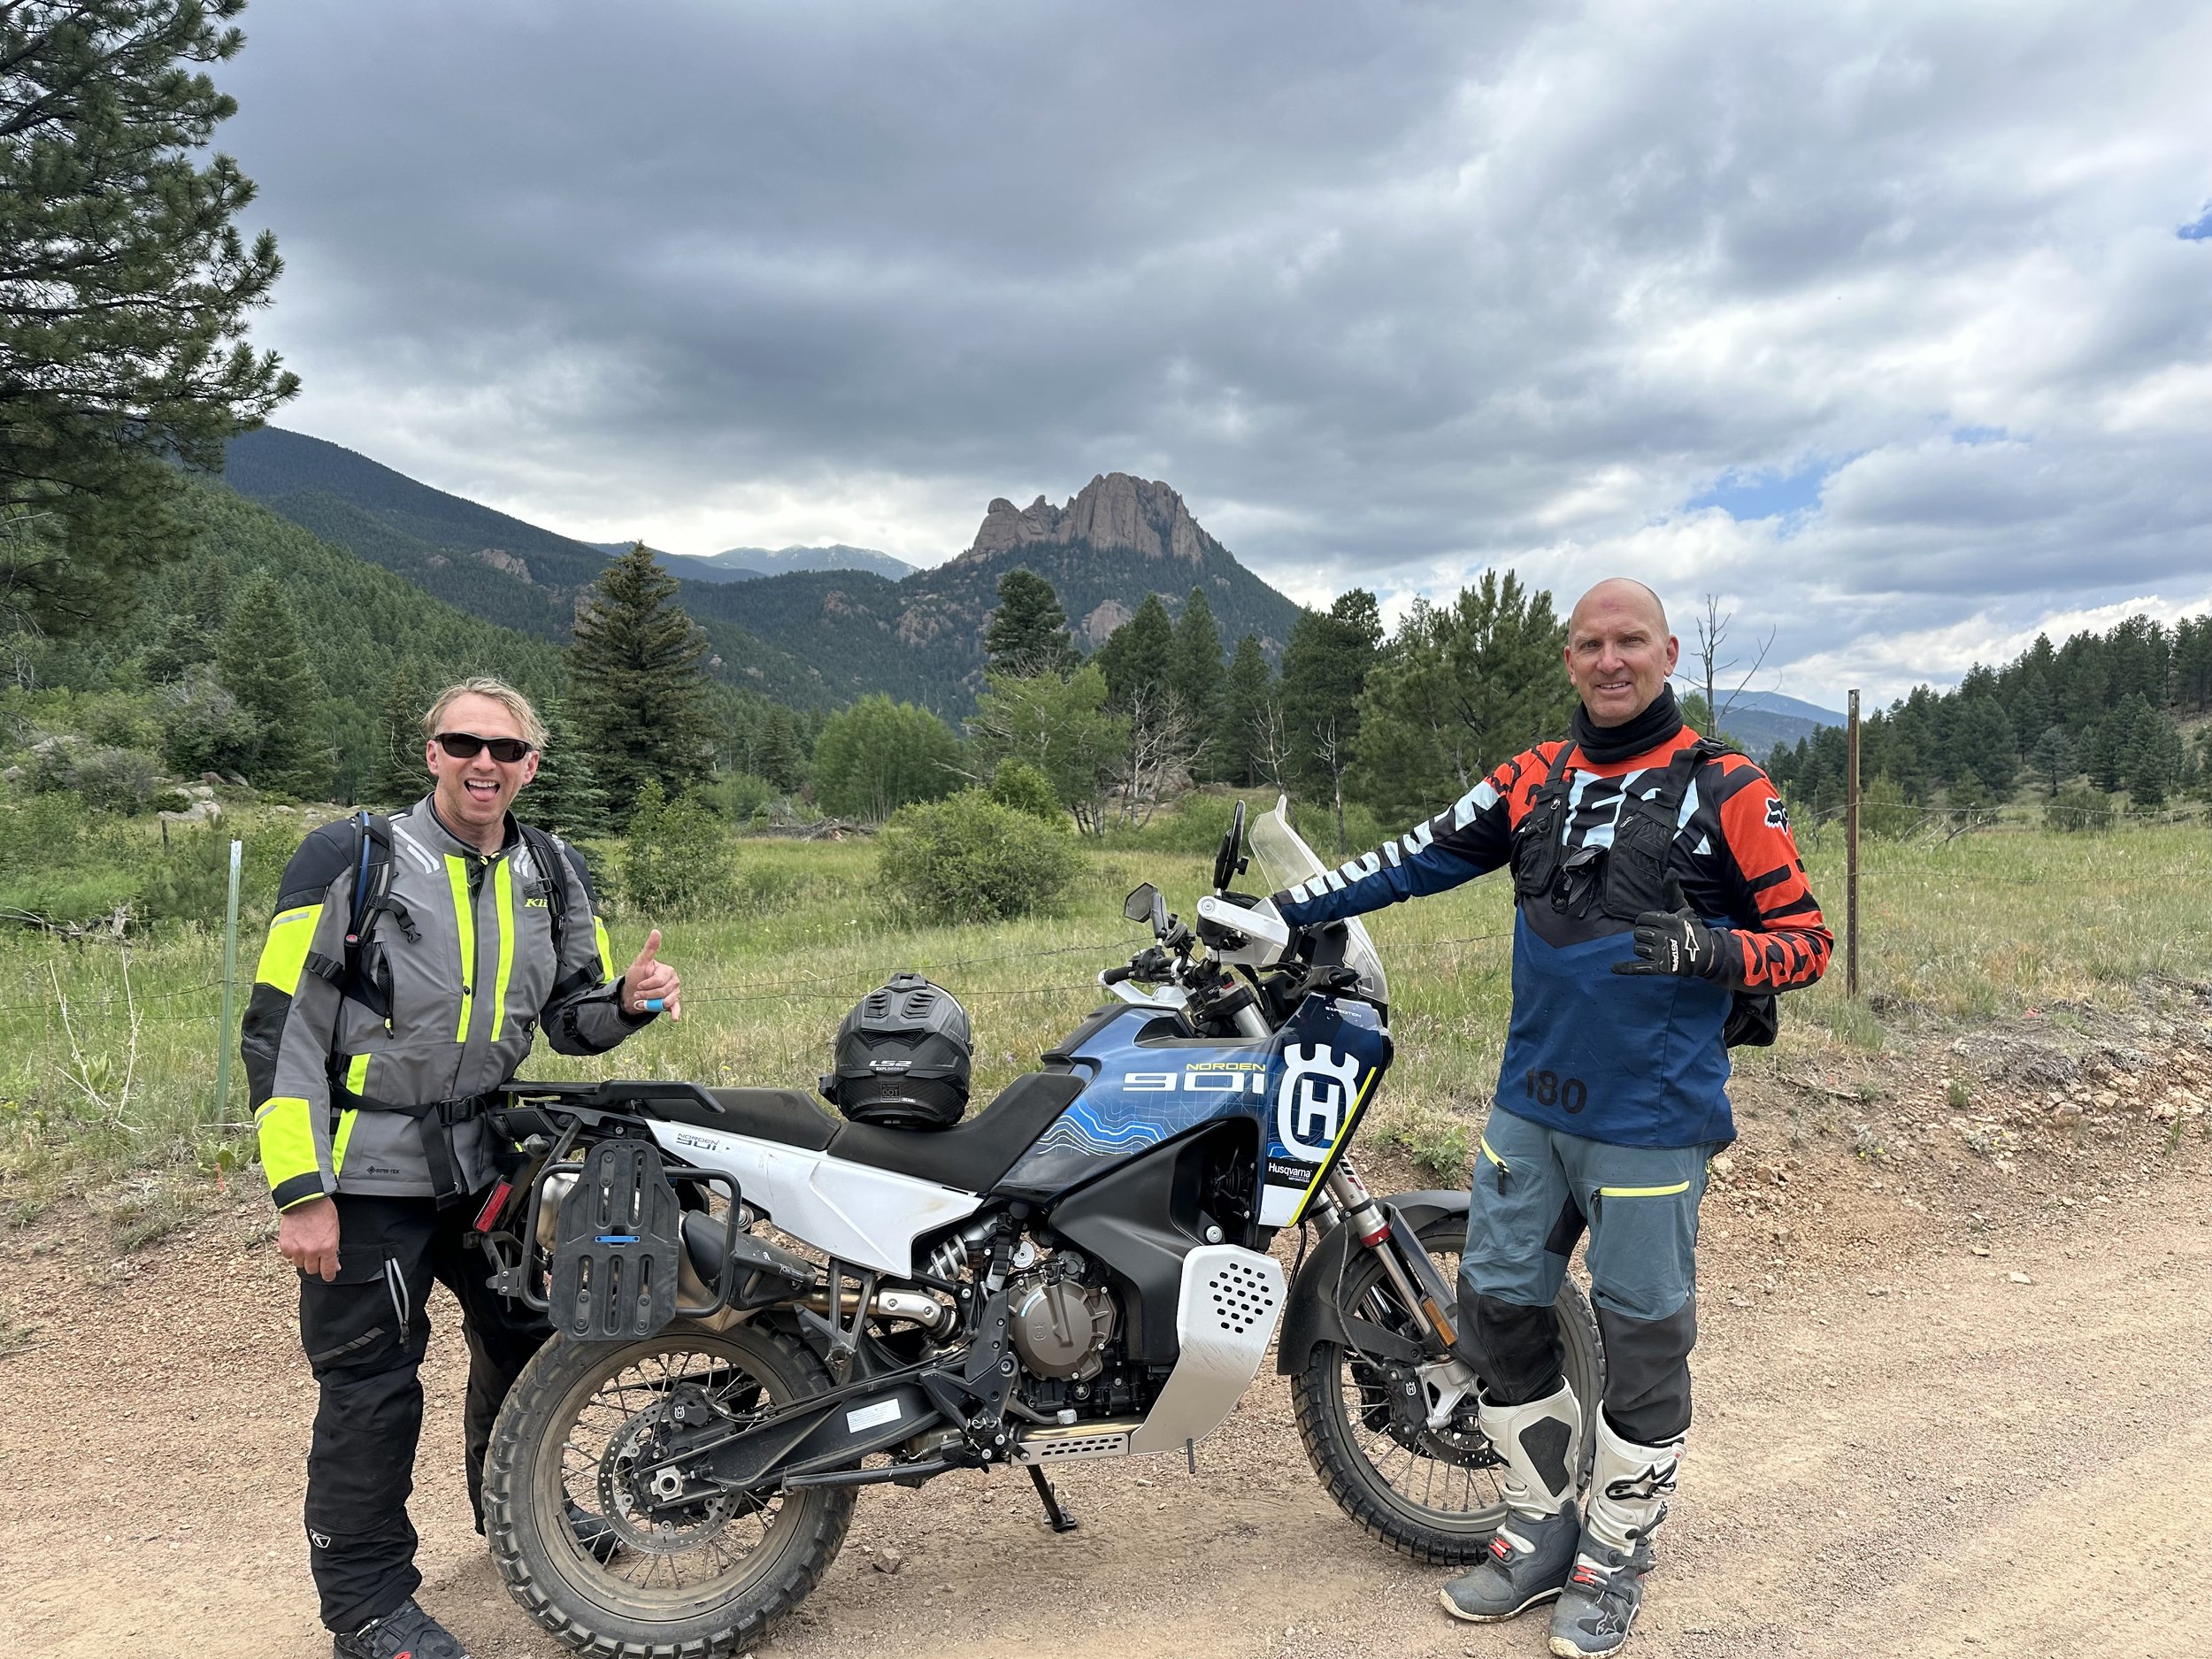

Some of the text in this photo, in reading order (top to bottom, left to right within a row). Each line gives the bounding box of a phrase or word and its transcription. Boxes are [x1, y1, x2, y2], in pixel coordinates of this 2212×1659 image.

[1325, 1006, 1362, 1018] EXPEDITION
[1186, 1063, 1266, 1072] NORDEN
[1123, 1072, 1265, 1094] 901
[1526, 1066, 1587, 1114] 180
[678, 1133, 719, 1146] NORDEN
[1268, 1162, 1311, 1178] Husqvarna
